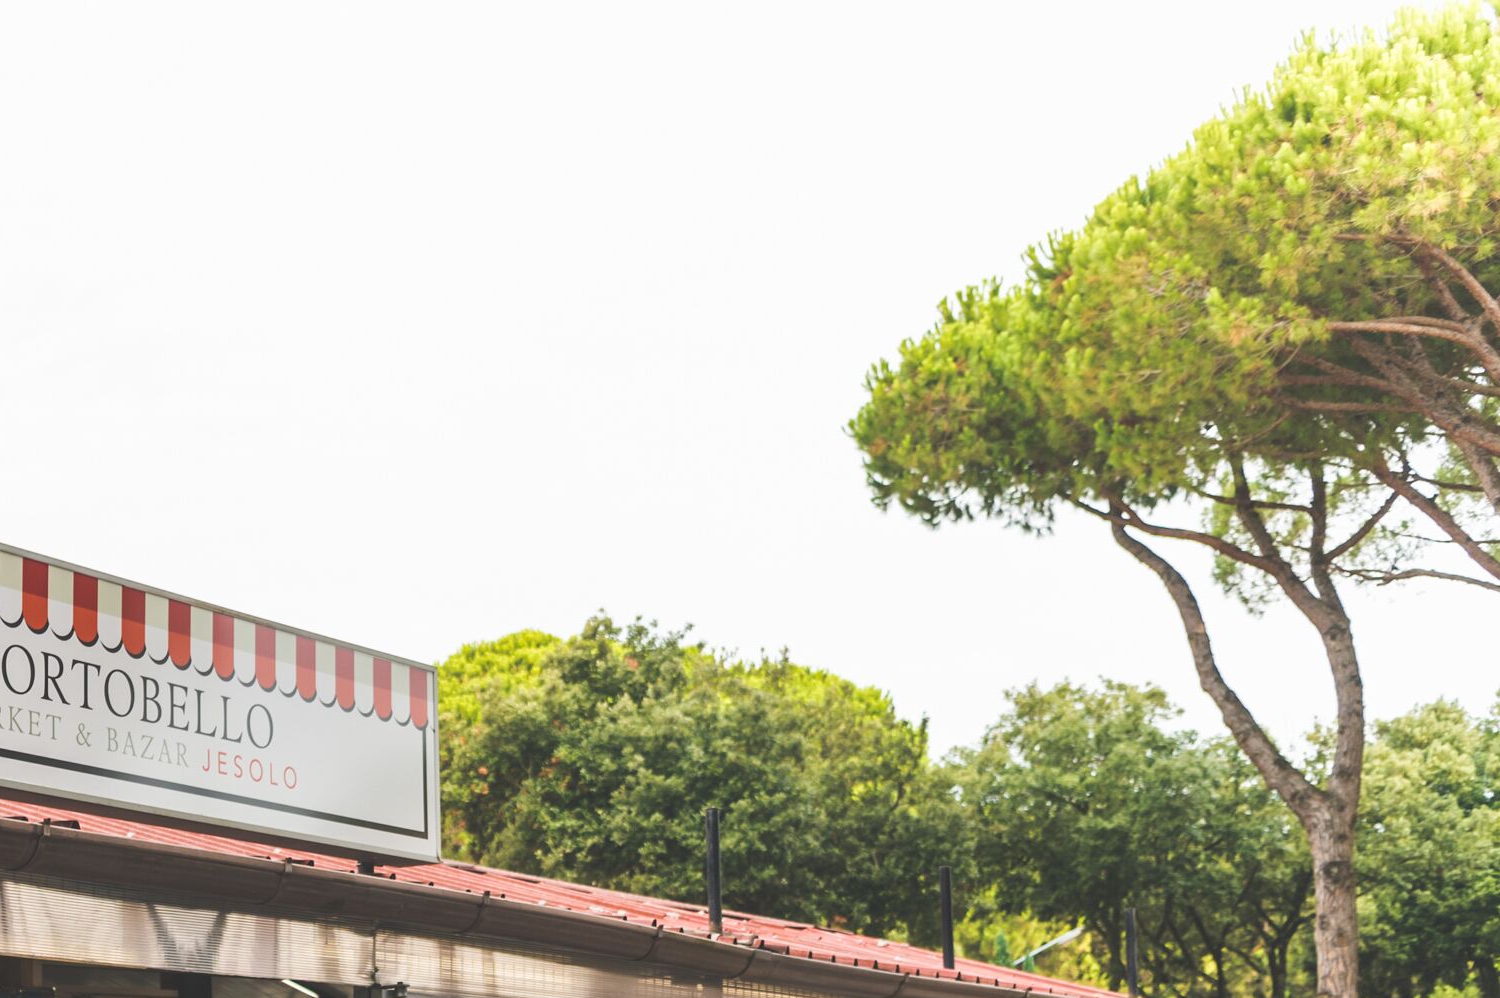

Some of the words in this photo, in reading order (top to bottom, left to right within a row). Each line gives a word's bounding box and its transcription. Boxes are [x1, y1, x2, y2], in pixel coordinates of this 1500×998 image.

[76, 722, 92, 748] &
[107, 726, 190, 769] BAZAR
[202, 748, 298, 790] JESOLO
